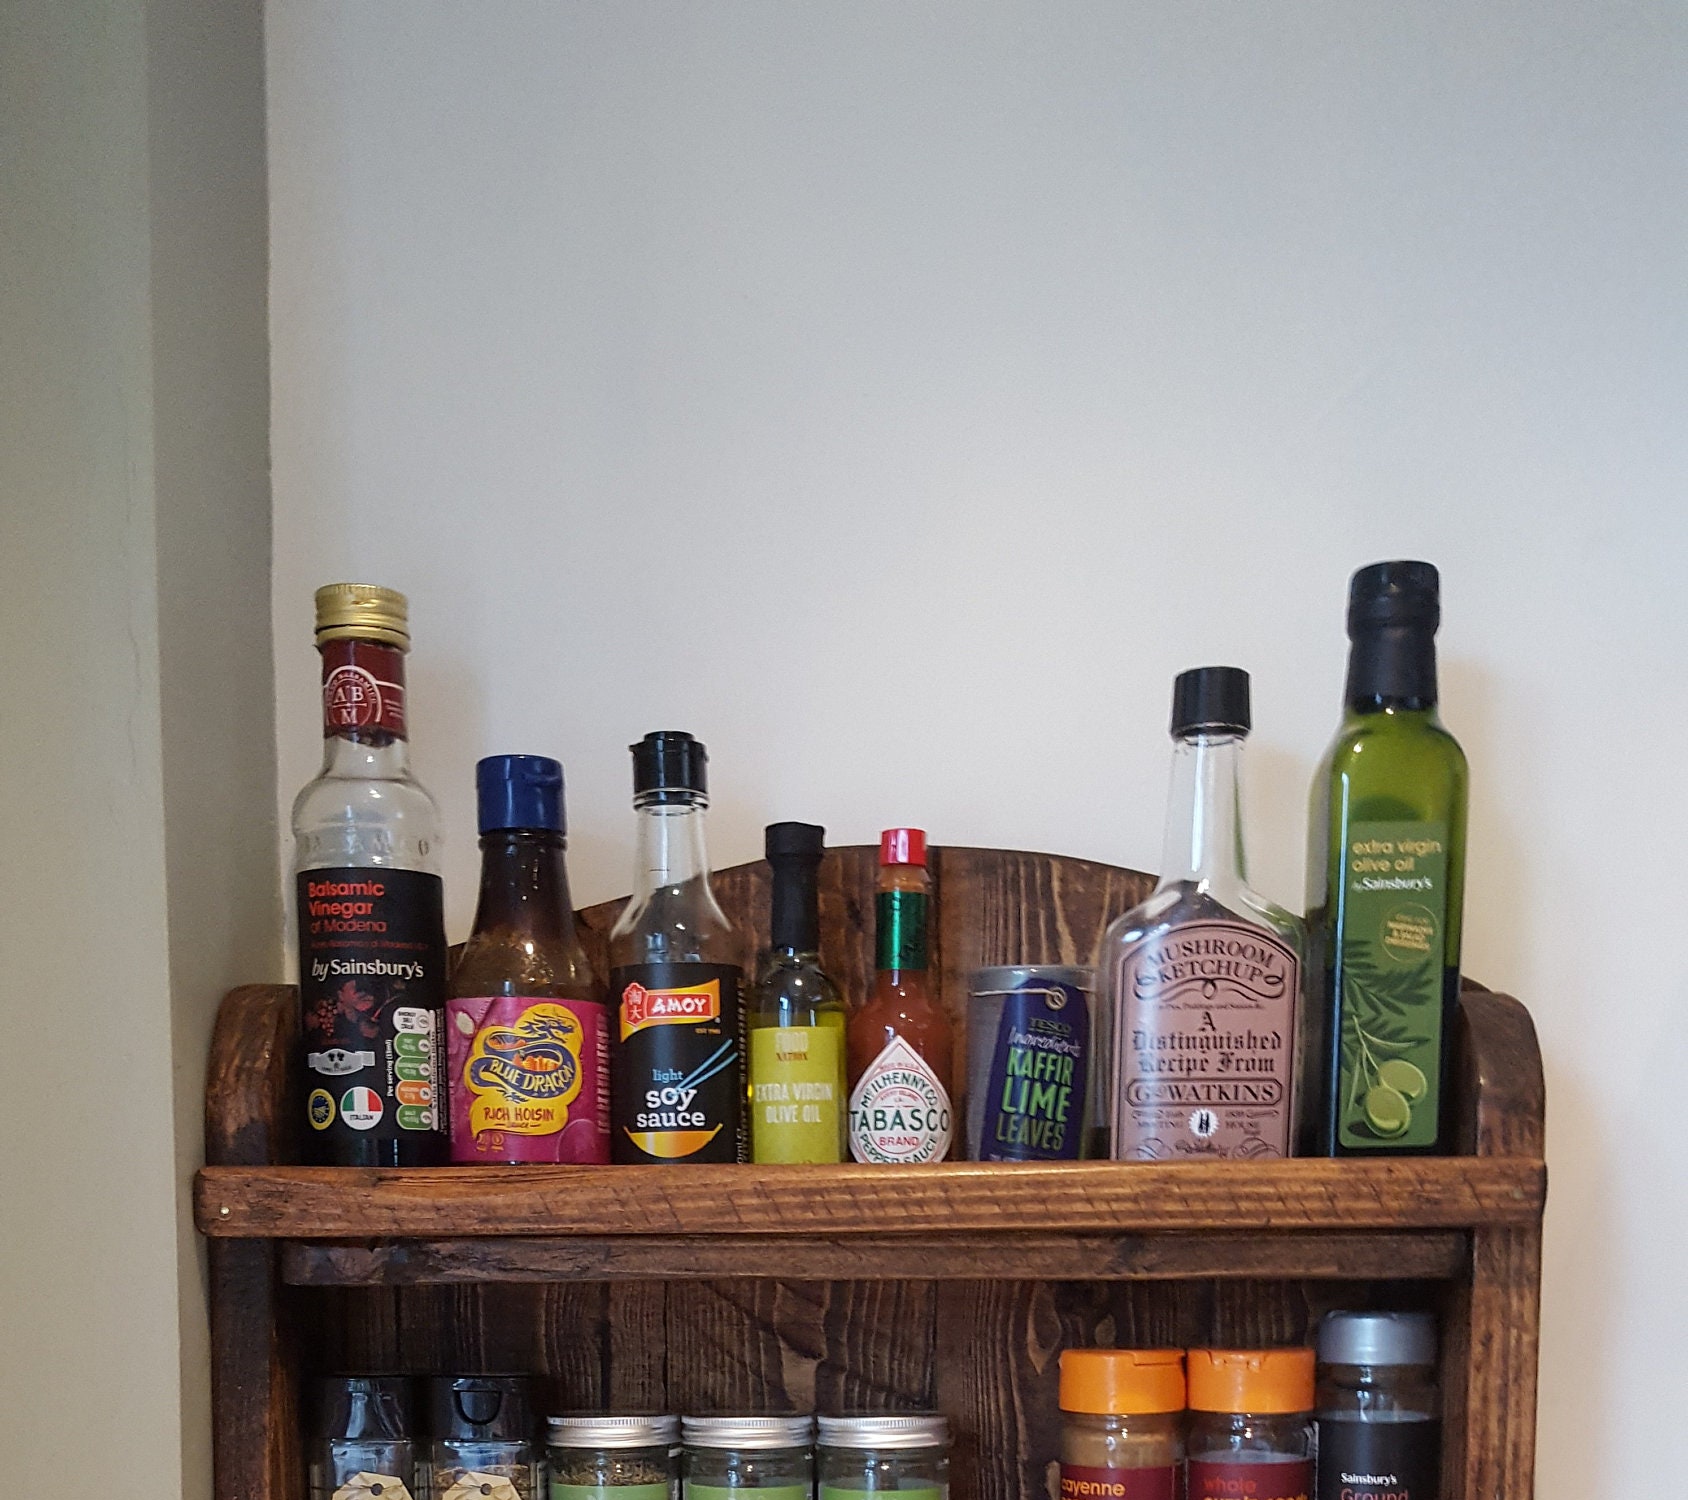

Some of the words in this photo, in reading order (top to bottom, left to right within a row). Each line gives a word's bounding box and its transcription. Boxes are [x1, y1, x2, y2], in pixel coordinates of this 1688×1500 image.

[333, 686, 347, 703] A
[351, 686, 364, 701] B
[340, 708, 358, 725] M
[1352, 840, 1394, 854] extra
[1352, 857, 1391, 872] olive
[308, 880, 385, 897] Balsamic
[1362, 876, 1433, 891] Sainsbury's
[309, 901, 374, 919] Vinegar
[323, 920, 387, 932] Modena
[1147, 939, 1274, 968] MUSHROOM
[311, 958, 329, 982] by
[330, 959, 424, 980] Sainsbury's
[1158, 959, 1263, 984] KETCHUP
[651, 997, 707, 1014] AMOY
[1199, 1011, 1216, 1032] A
[1133, 1030, 1281, 1054] Distinguished
[1007, 1046, 1074, 1086] KAFFIR
[1138, 1052, 1209, 1077] Recipe
[1217, 1051, 1275, 1073] From
[490, 1060, 521, 1086] BLUE
[522, 1062, 575, 1093] DRAGON
[652, 1069, 684, 1083] light
[645, 1087, 698, 1111] soy
[756, 1084, 789, 1102] EXTRA
[793, 1083, 833, 1100] VIRGIN
[1001, 1076, 1073, 1123] LIME
[483, 1107, 510, 1121] RICH
[514, 1107, 555, 1121] HOISIN
[636, 1111, 706, 1128] sauce
[765, 1105, 798, 1123] OLIVE
[802, 1105, 821, 1122] OIL
[850, 1109, 950, 1132] TABASCO
[880, 1136, 919, 1146] BRAND
[995, 1113, 1065, 1151] LEAVES
[1204, 1477, 1256, 1494] whole
[1340, 1473, 1397, 1486] Sainsbury's
